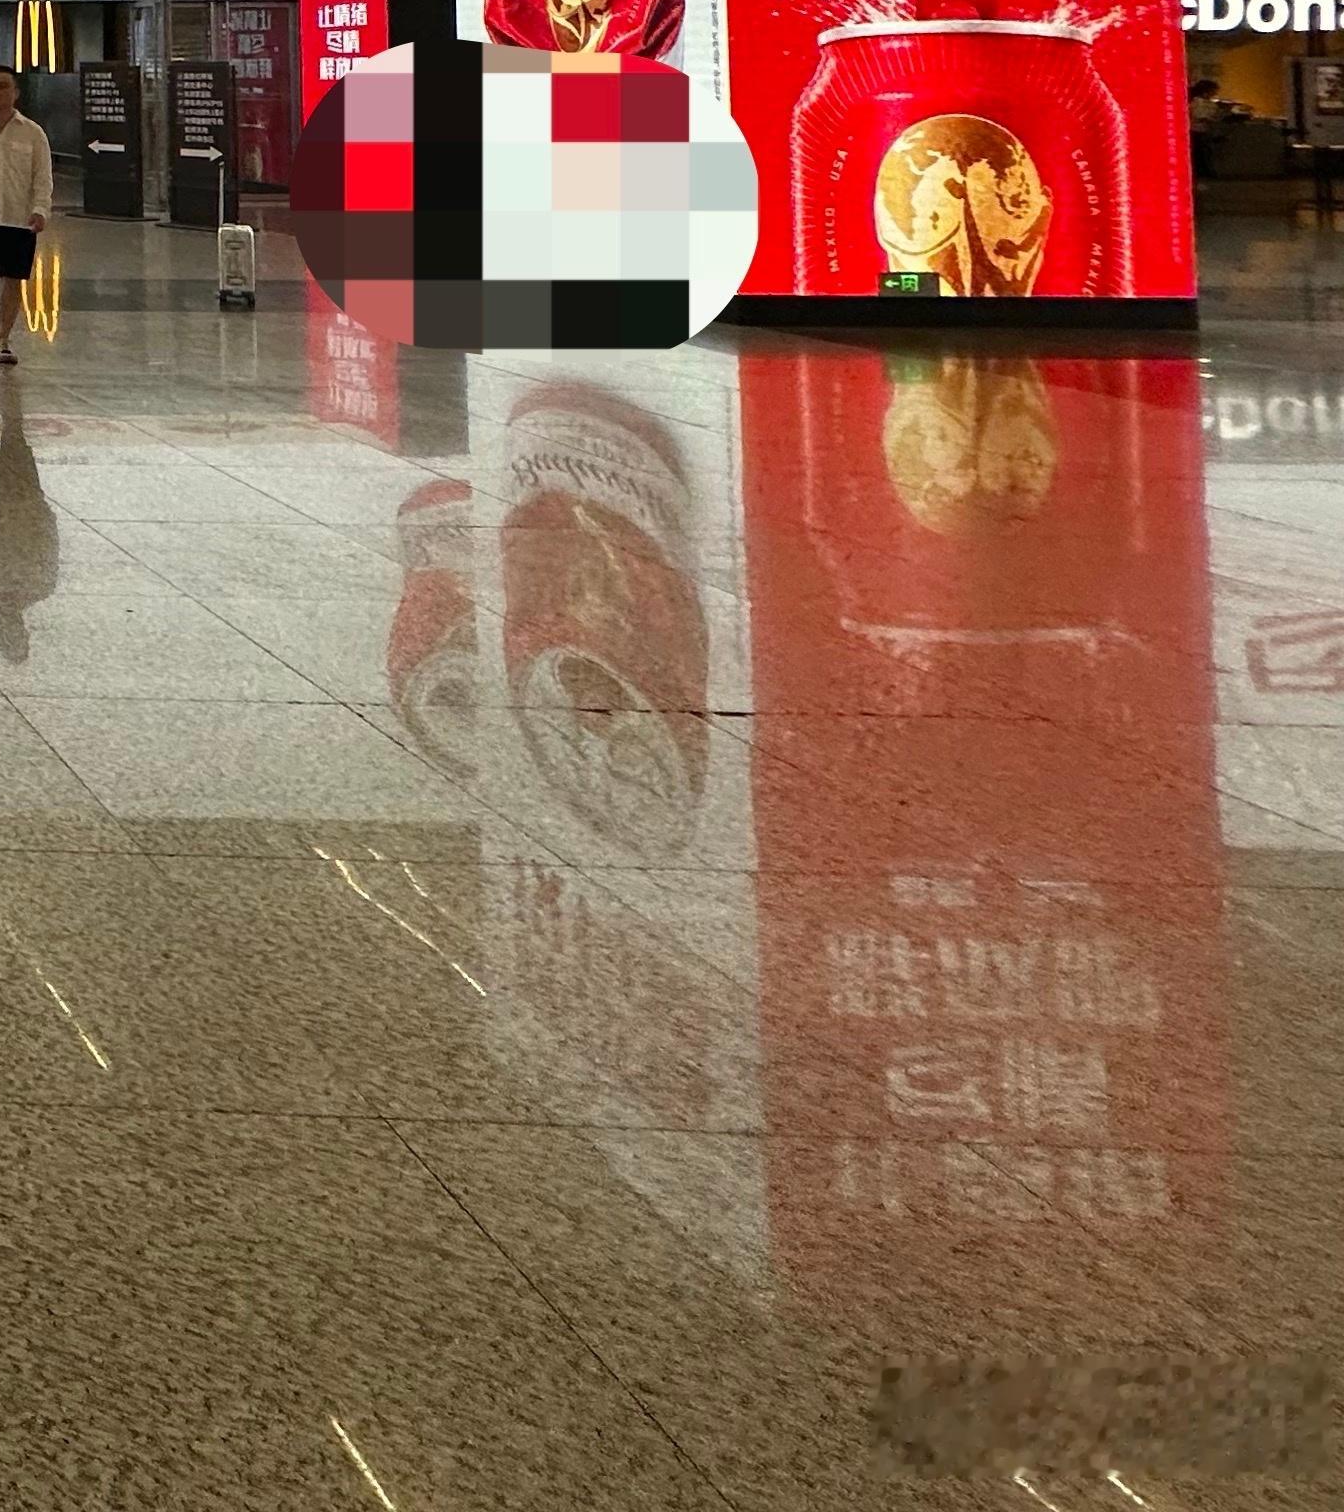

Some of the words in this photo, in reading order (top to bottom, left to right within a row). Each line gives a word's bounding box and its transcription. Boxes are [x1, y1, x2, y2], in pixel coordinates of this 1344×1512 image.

[317, 2, 368, 29] 让情绪
[326, 29, 361, 54] 尽情
[831, 148, 849, 182] USA
[1071, 148, 1102, 216] CANADA
[825, 207, 842, 274] MEXICO
